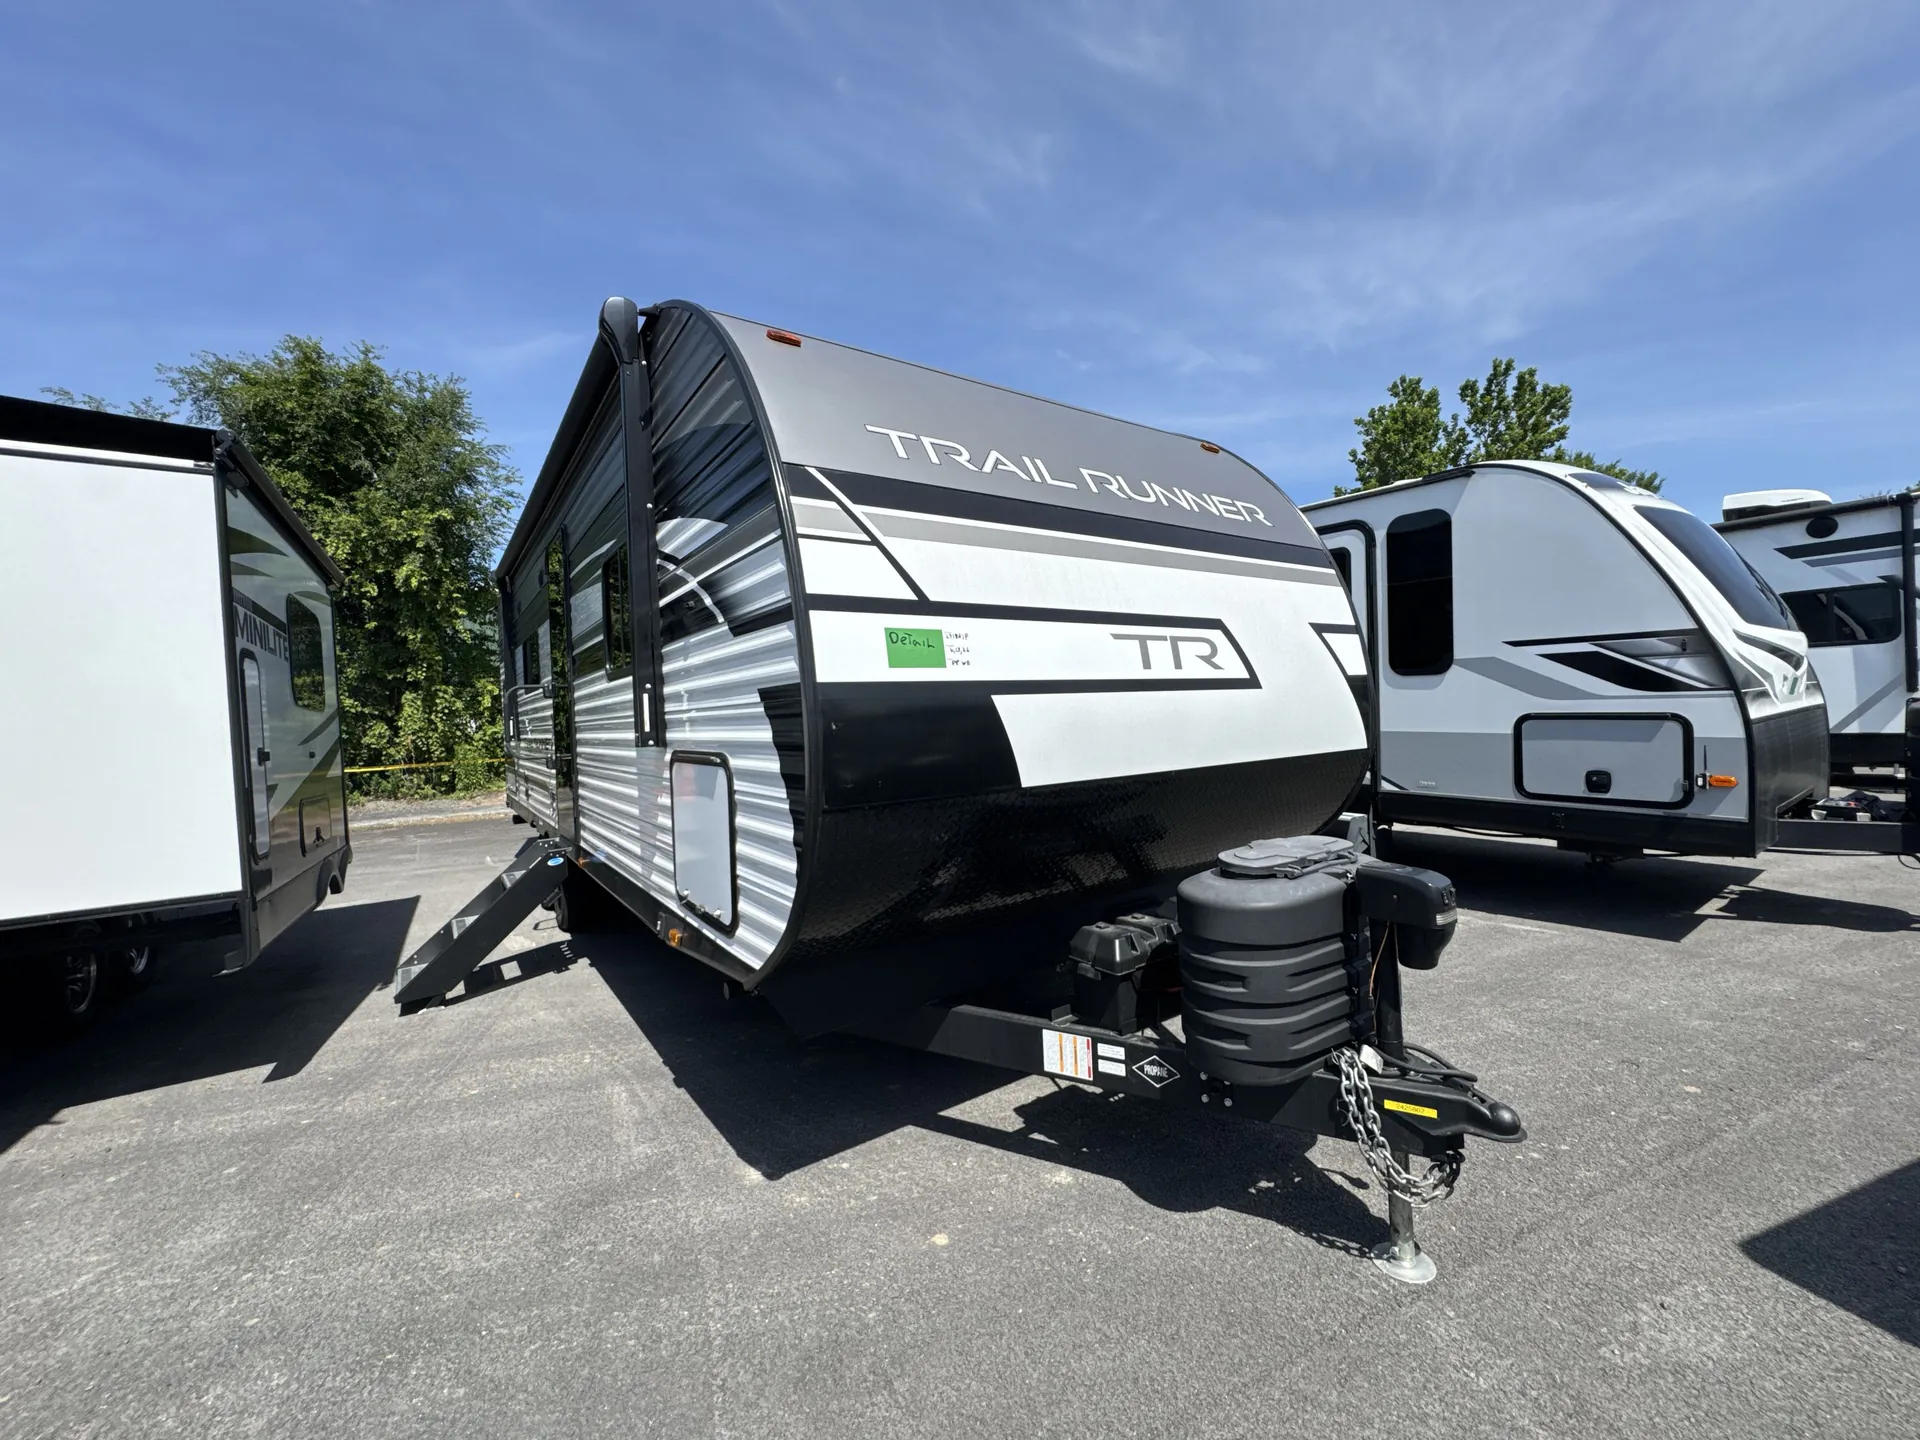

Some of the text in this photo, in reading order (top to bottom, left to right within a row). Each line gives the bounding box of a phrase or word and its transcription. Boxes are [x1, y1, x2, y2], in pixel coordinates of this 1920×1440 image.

[864, 424, 1275, 527] TRAIL RUNNER
[233, 604, 289, 663] MINILITE
[1109, 633, 1225, 670] TR
[1143, 1064, 1168, 1077] PROPANE
